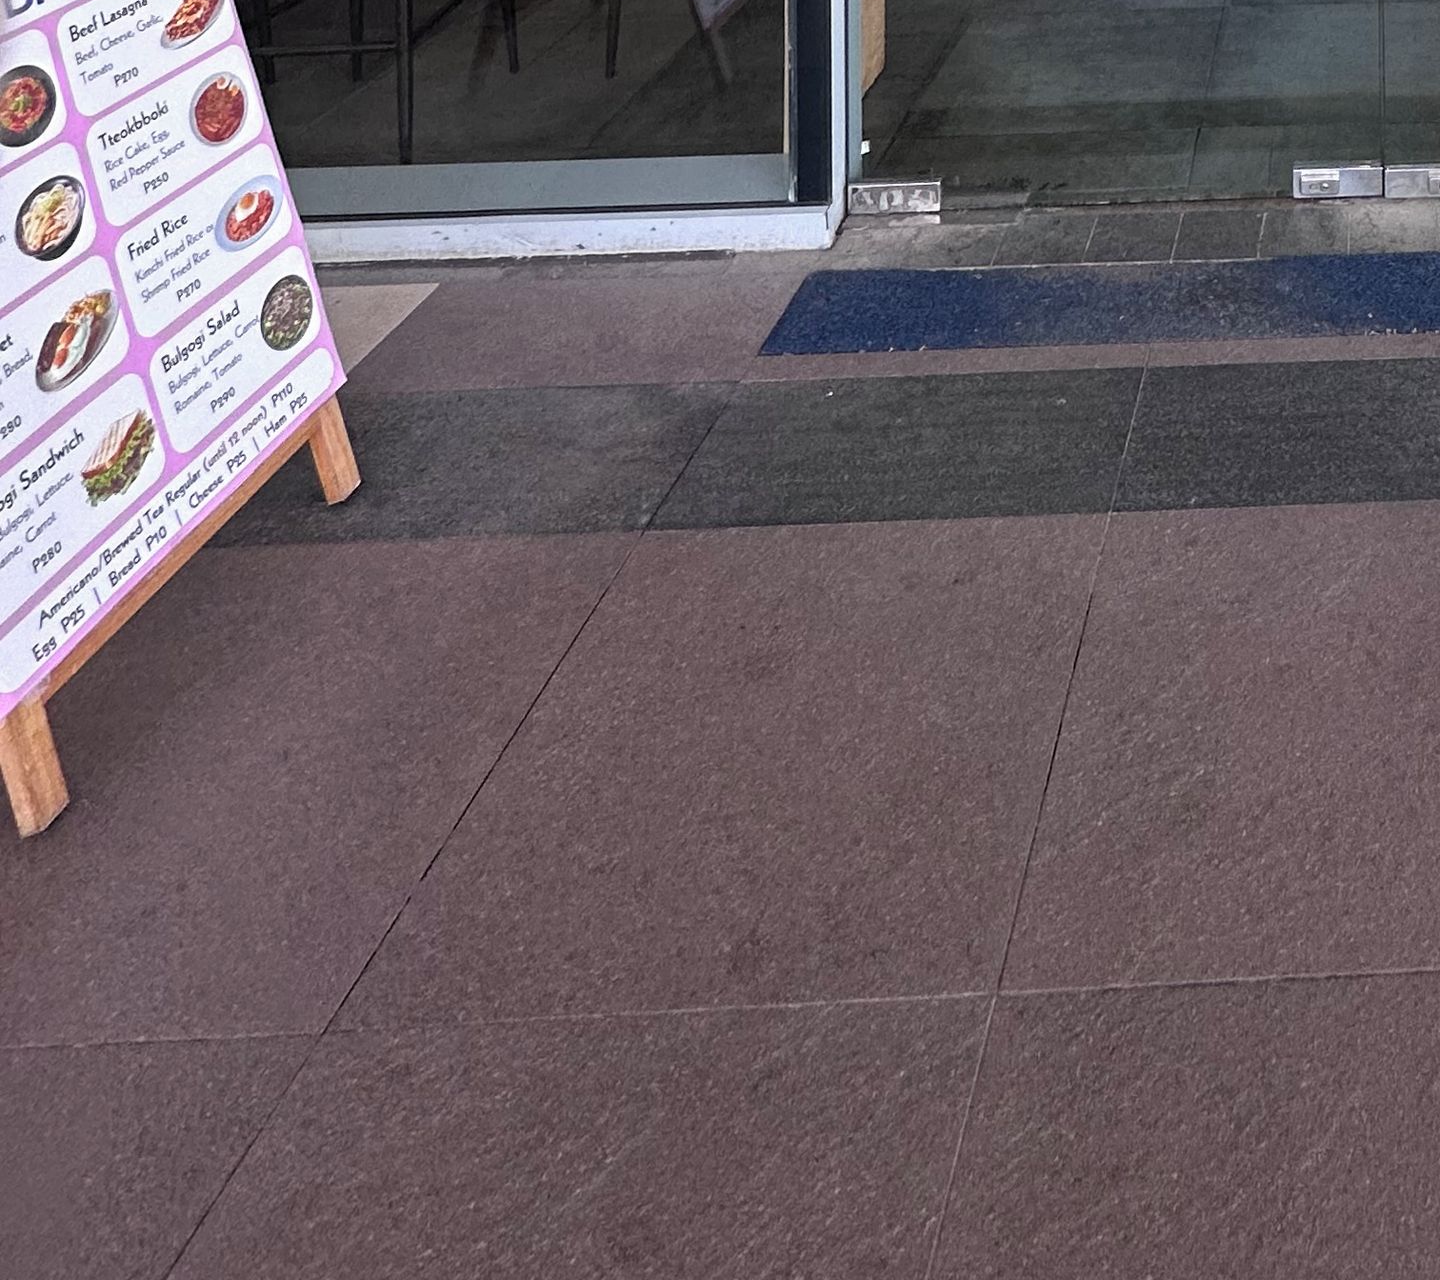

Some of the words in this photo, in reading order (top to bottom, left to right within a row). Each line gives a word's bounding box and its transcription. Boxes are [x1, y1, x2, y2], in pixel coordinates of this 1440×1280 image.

[69, 16, 98, 42] Beef
[114, 67, 139, 87] P270
[98, 101, 169, 150] Tteokbboki
[109, 173, 127, 191] Red
[129, 156, 160, 182] Pepper
[160, 140, 185, 159] Sauce
[143, 171, 169, 194] P250
[127, 228, 159, 261] Fried
[161, 213, 188, 238] Rice
[161, 330, 206, 373] Bulgogi
[206, 299, 240, 335] Salad
[210, 386, 236, 414] P290
[19, 427, 85, 491] Sandwich
[143, 508, 165, 525] Tea
[165, 468, 201, 506] Regular
[25, 511, 57, 543] Carrot
[31, 636, 58, 662] Egg
[60, 604, 85, 634] P25
[108, 548, 142, 588] Bread
[145, 525, 168, 552] P10
[189, 474, 224, 509] Cheese
[226, 450, 247, 474] P25
[264, 414, 287, 438] Ham
[289, 392, 308, 414] P25
[32, 541, 62, 574] P280
